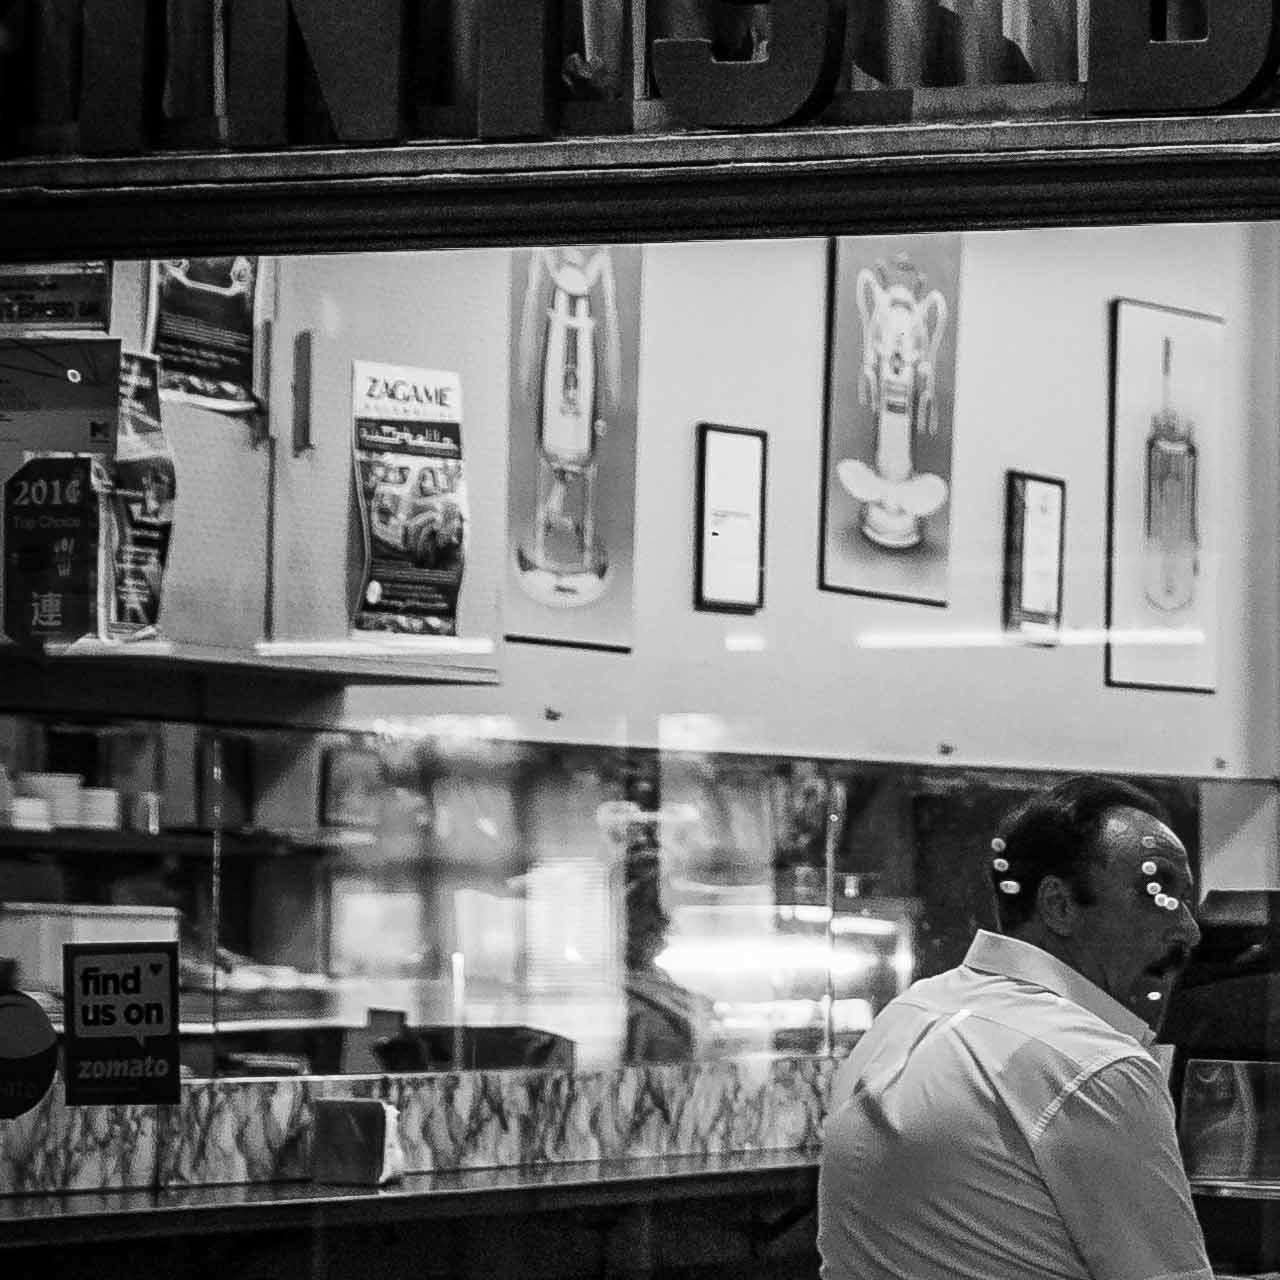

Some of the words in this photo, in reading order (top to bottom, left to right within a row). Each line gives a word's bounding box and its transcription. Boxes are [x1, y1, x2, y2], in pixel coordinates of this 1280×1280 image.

[365, 375, 453, 408] ZAGAME
[13, 480, 80, 504] 2016
[81, 965, 141, 995] find
[82, 1004, 116, 1026] us
[124, 1003, 163, 1025] on
[78, 1055, 169, 1079] zomato
